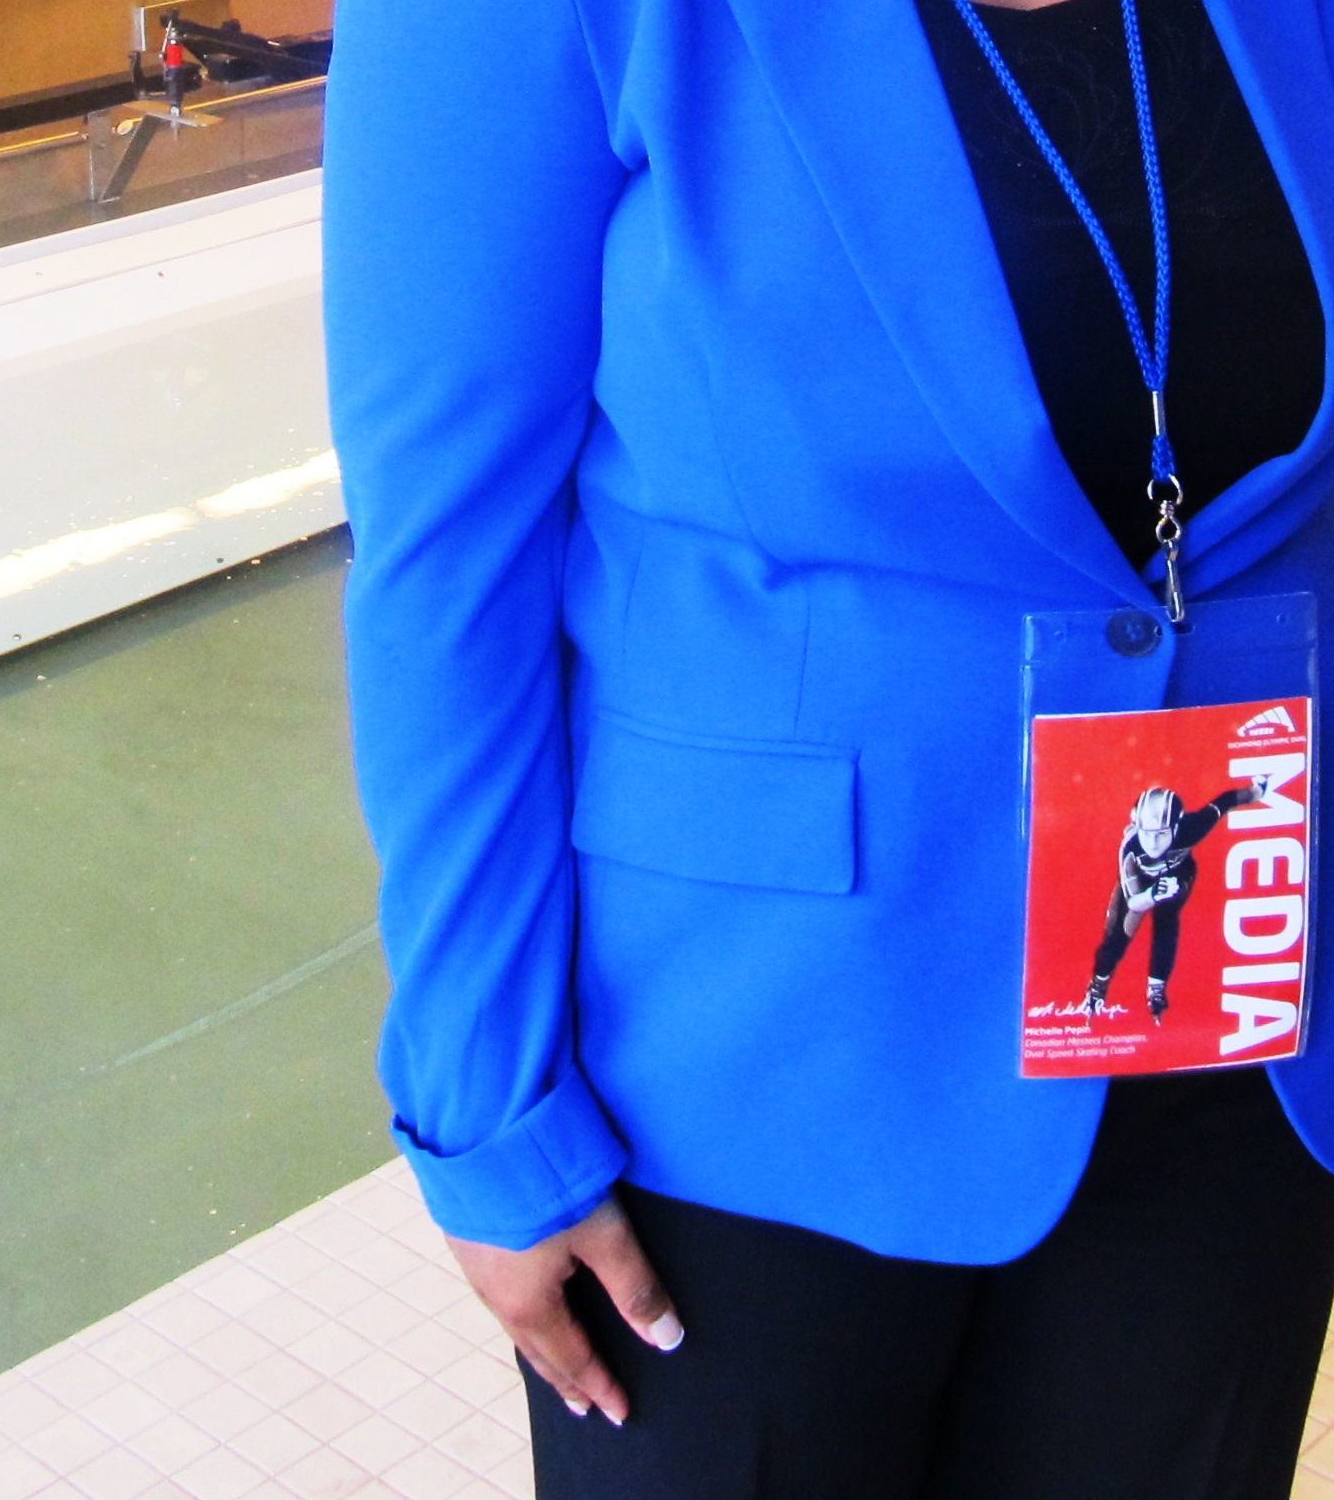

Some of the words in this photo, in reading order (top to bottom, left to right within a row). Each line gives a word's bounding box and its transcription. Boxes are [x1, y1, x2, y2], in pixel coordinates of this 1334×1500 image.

[1219, 752, 1305, 1056] MEDIA
[1025, 1028, 1063, 1036] Michelle
[1065, 1026, 1091, 1035] Pepin
[1025, 1039, 1065, 1047] Canadian
[1067, 1037, 1101, 1046] Masters
[1024, 1050, 1045, 1058] Oval
[1047, 1049, 1074, 1059] Speed
[1076, 1047, 1108, 1057] Skating
[1110, 1046, 1136, 1055] Coach
